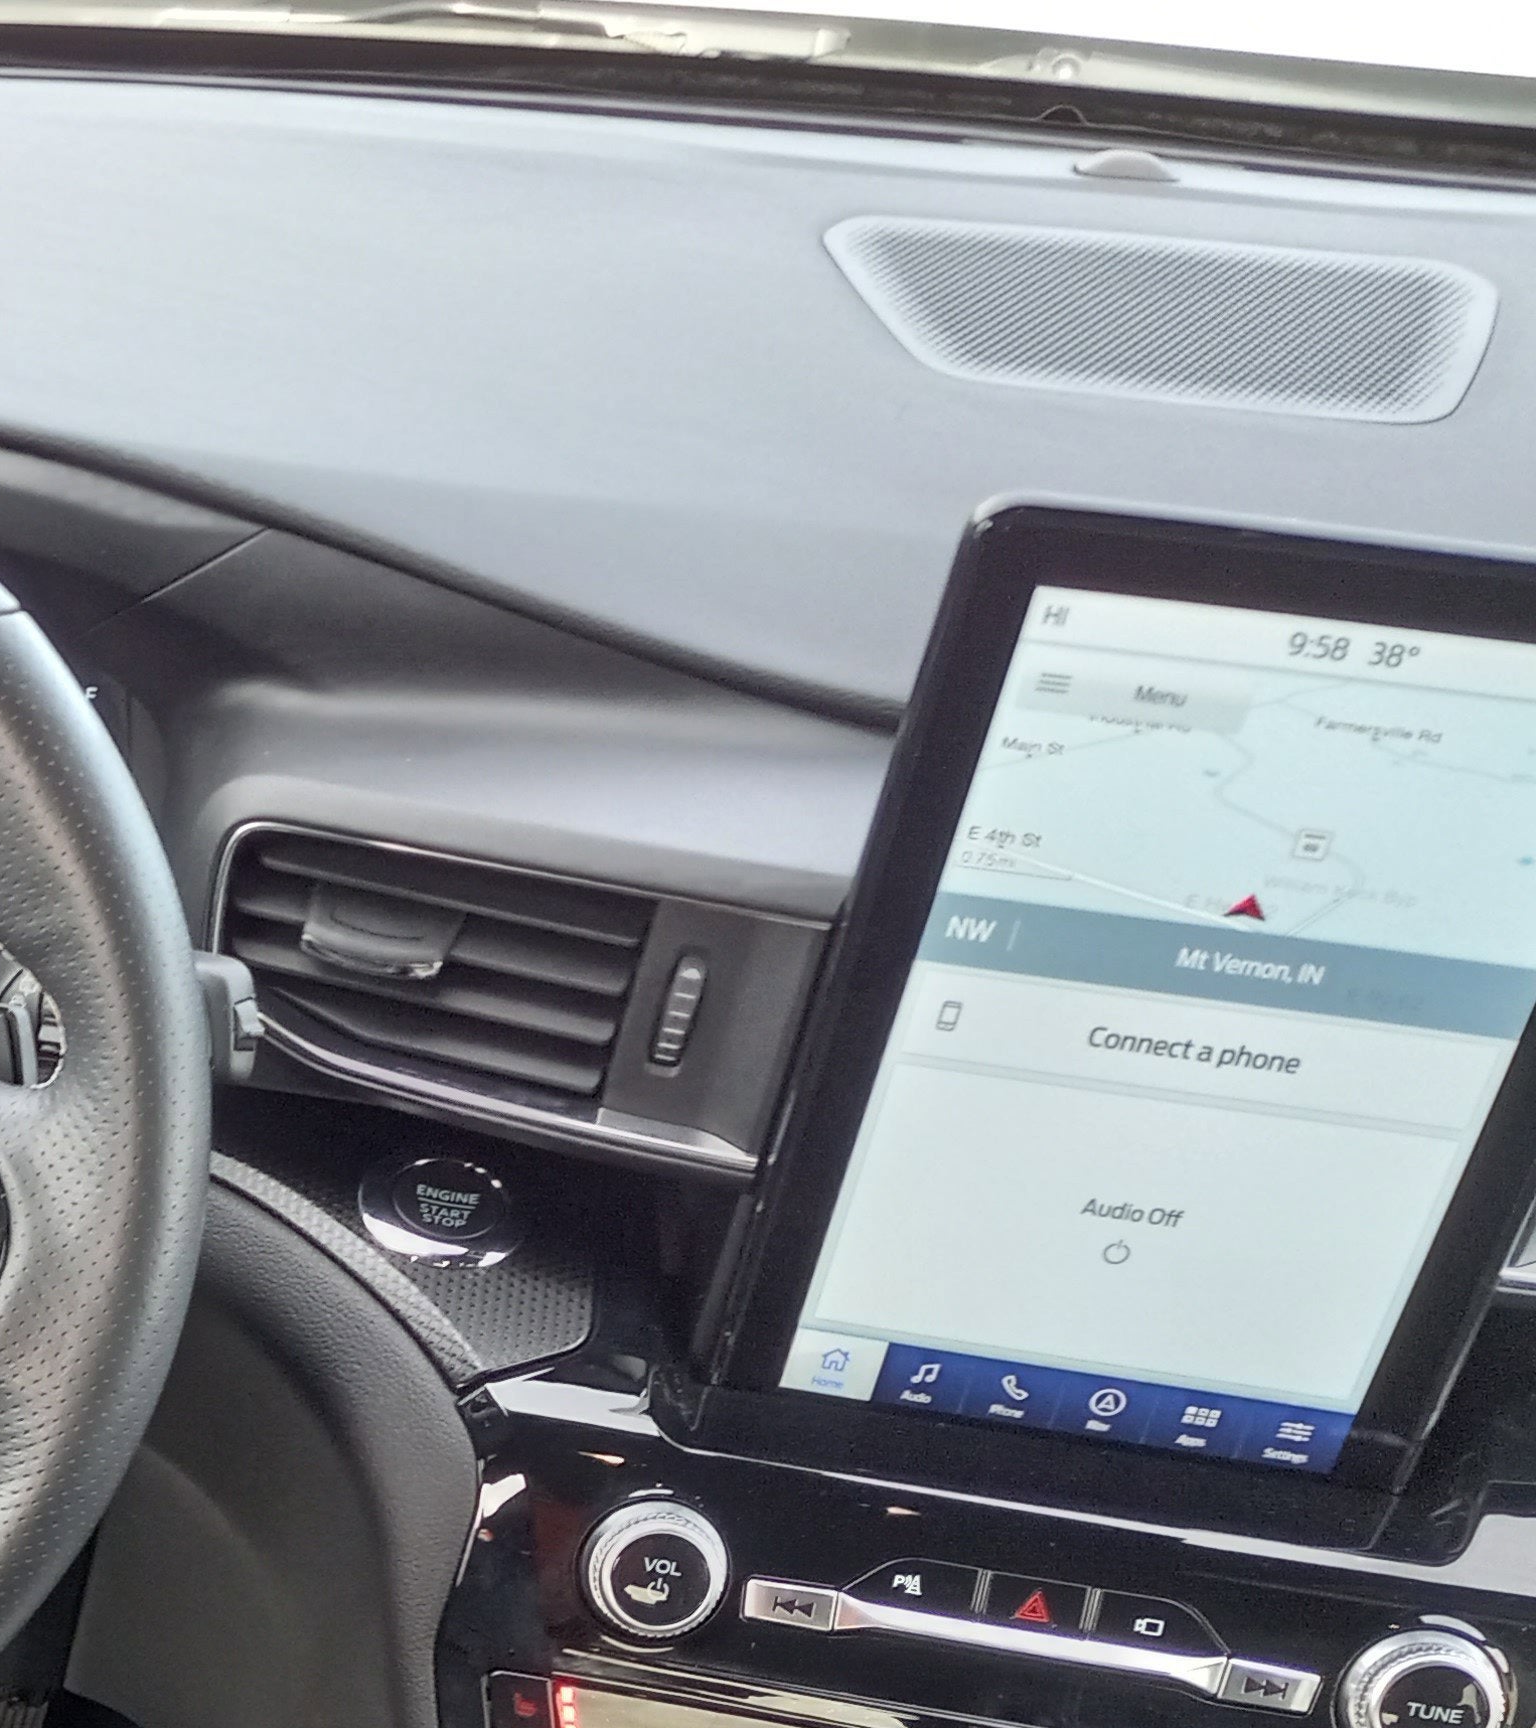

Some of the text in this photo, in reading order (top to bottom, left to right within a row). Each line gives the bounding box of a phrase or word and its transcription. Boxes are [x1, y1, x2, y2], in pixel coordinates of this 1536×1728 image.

[1288, 631, 1421, 669] 9:58 38°
[1132, 685, 1190, 708] Menu
[944, 915, 997, 943] NW
[1175, 947, 1326, 986] Mt Vernon, IN
[1088, 1026, 1302, 1075] Connect a phone
[416, 1184, 480, 1204] ENGINE
[419, 1203, 471, 1219] START
[423, 1213, 468, 1228] STOP
[1080, 1198, 1185, 1228] Audio Off
[643, 1556, 683, 1578] VOL
[1406, 1701, 1466, 1726] TUNE
